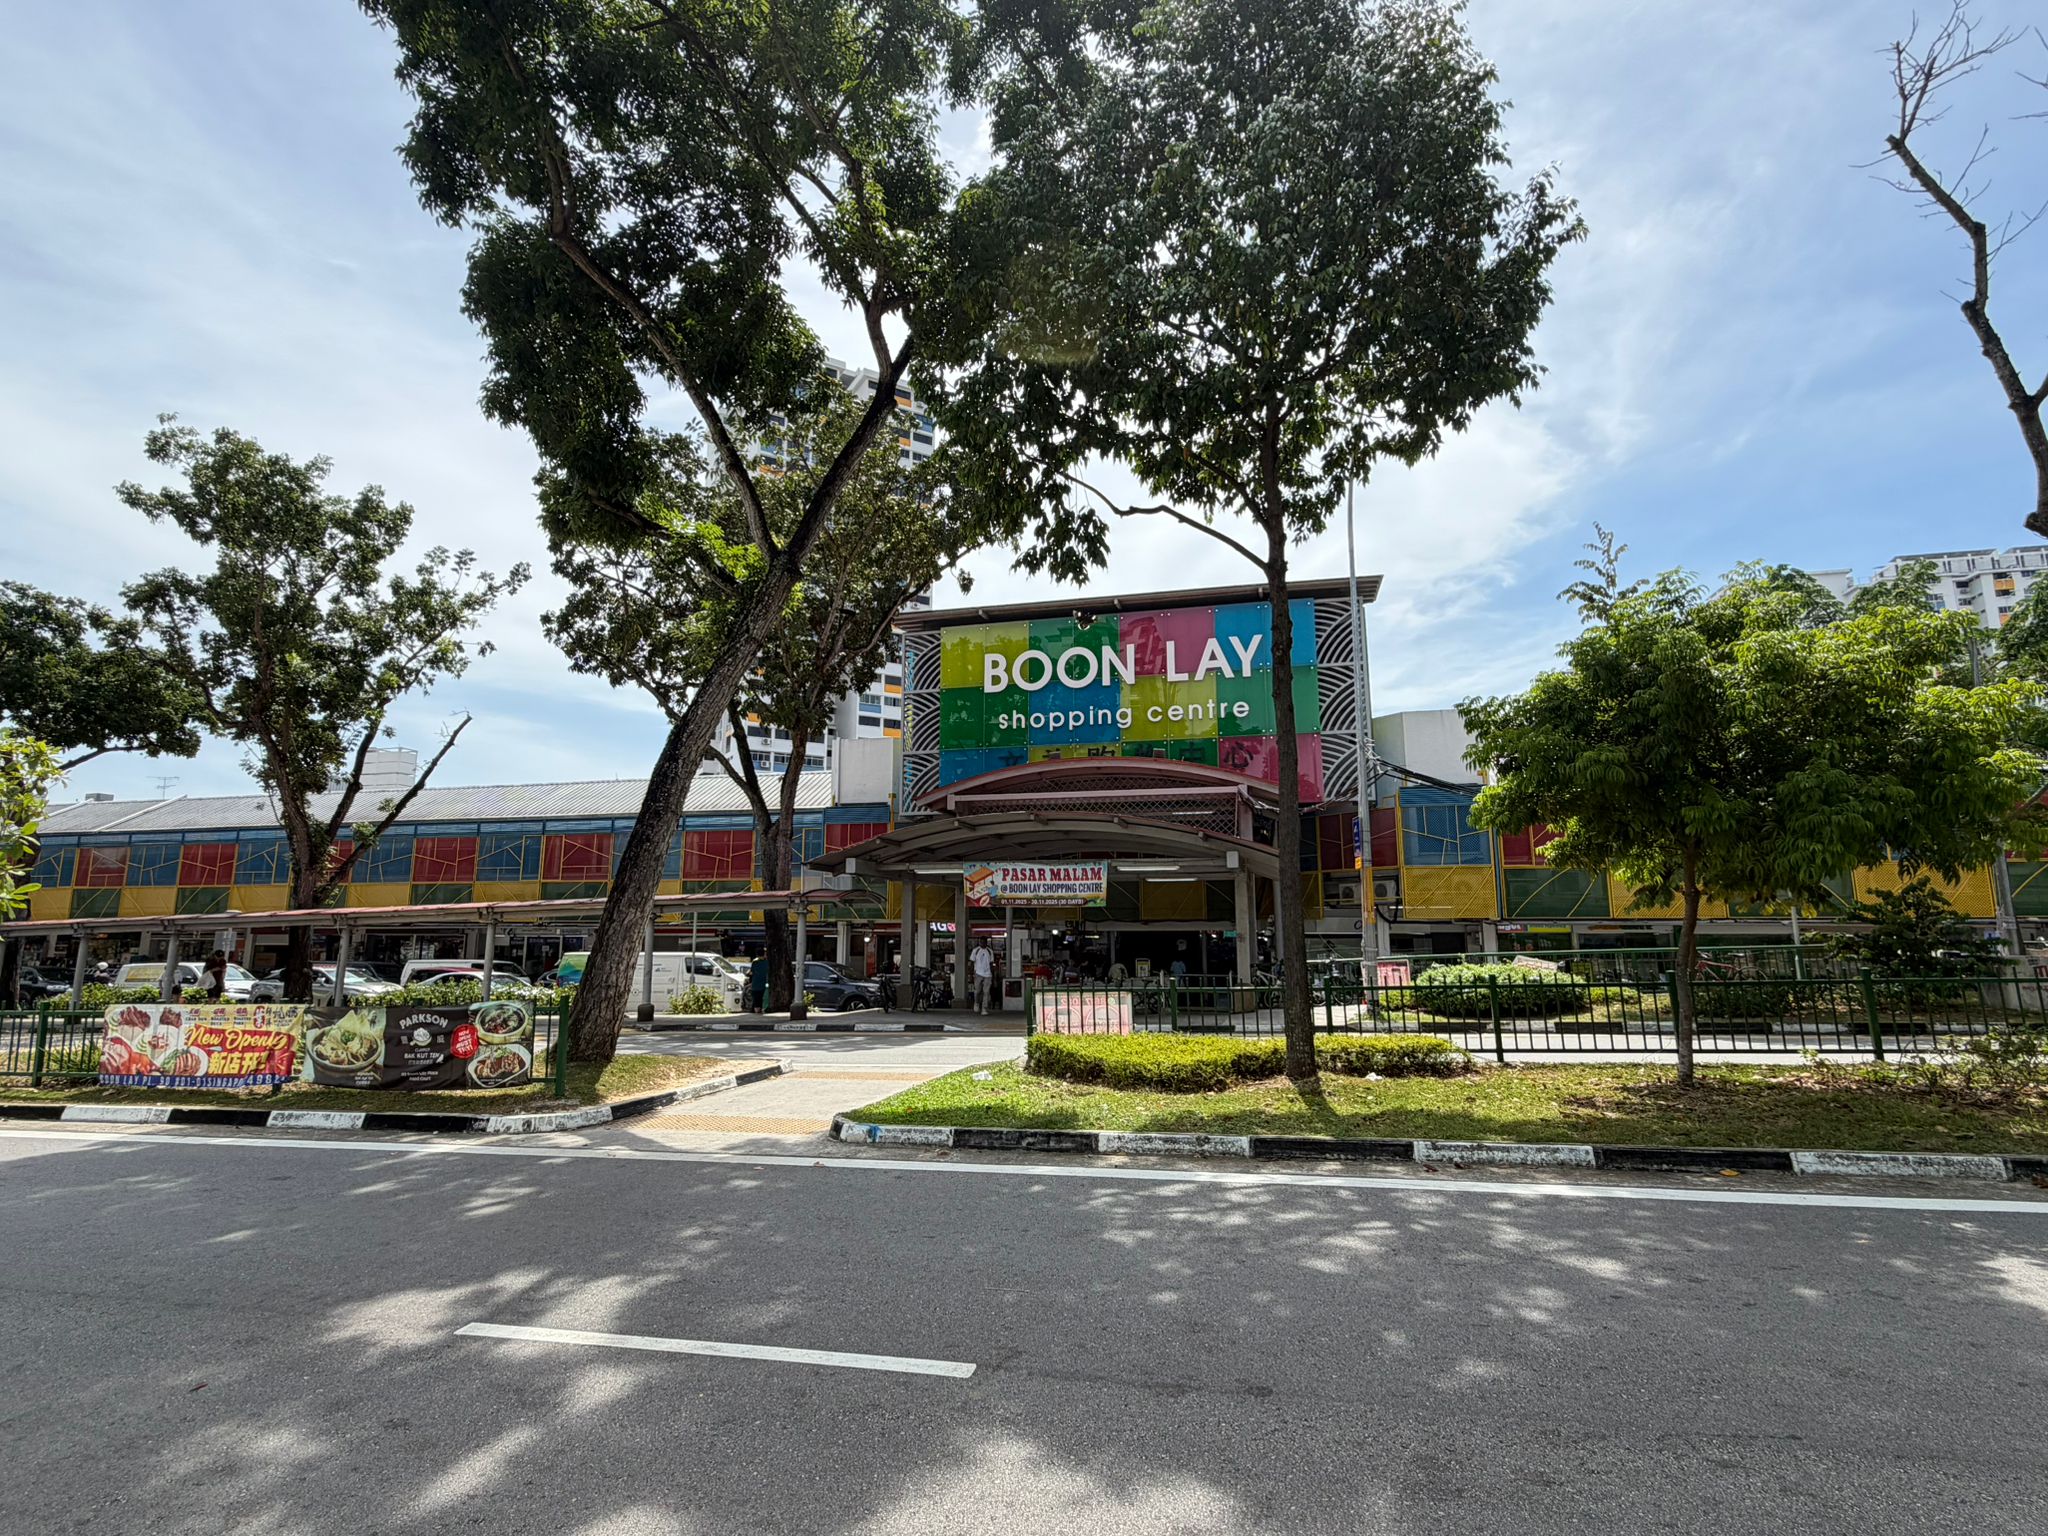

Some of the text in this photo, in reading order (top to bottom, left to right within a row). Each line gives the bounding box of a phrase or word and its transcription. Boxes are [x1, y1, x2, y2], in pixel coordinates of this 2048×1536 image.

[983, 634, 1263, 693] BOON LAY
[998, 698, 1250, 732] shopping centre
[1001, 867, 1103, 881] PASAR MALAM
[1000, 882, 1103, 894] @ BOON LAY SHOPPING CENTRE
[399, 1013, 449, 1030] PARKSON
[185, 1026, 224, 1047] New
[123, 1075, 139, 1086] LAY
